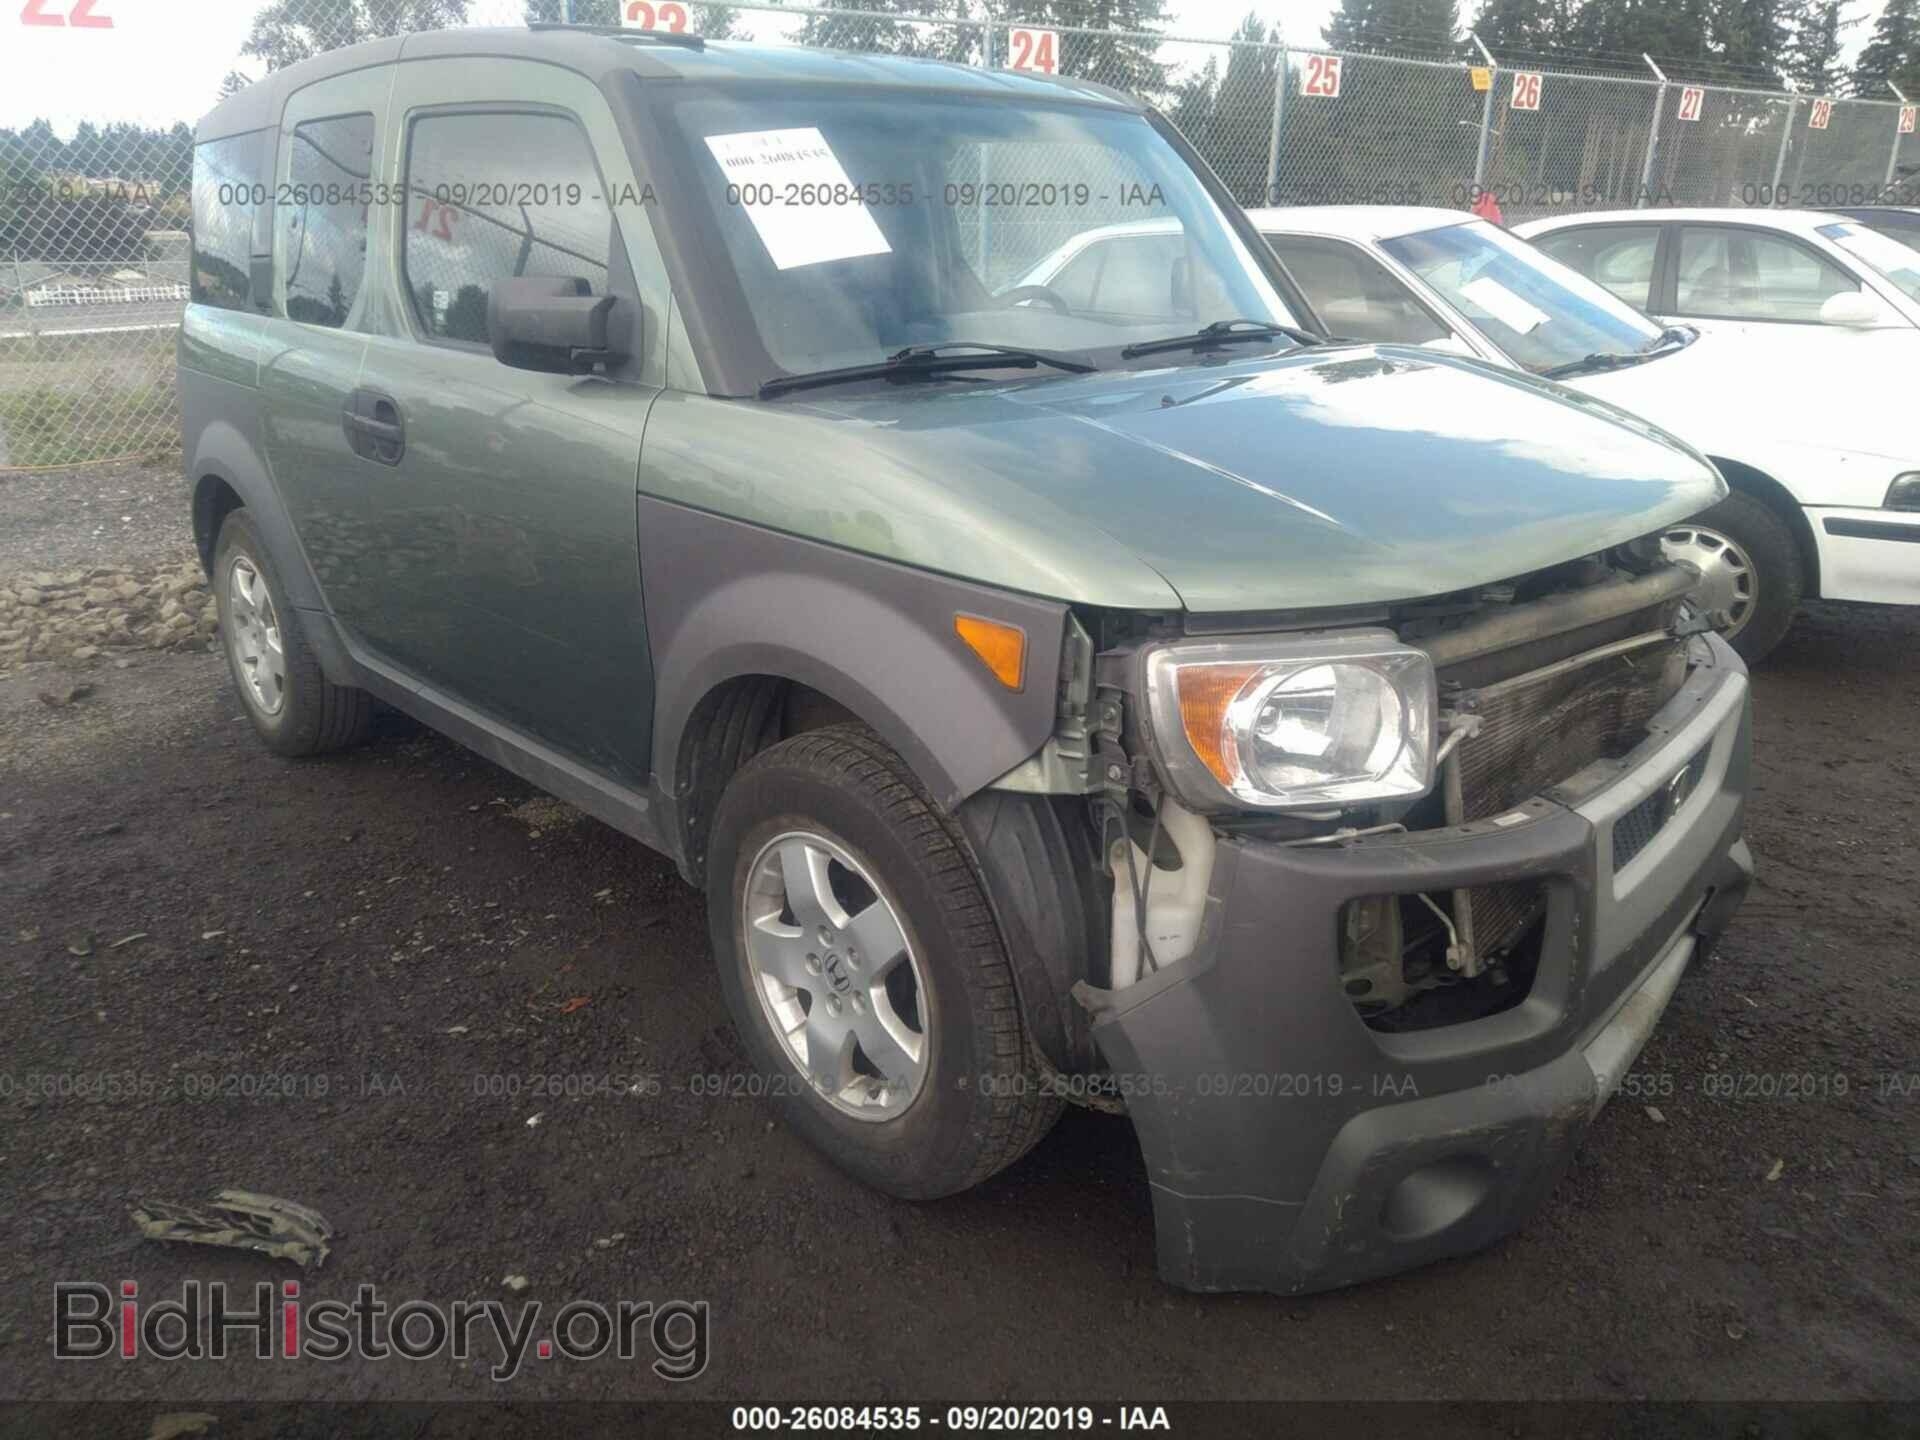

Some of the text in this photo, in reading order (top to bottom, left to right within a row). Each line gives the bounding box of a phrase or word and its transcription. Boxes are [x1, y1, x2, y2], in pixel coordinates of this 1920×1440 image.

[1013, 31, 1055, 74] 24
[1306, 56, 1338, 95] 25
[1513, 74, 1539, 107] 26
[1681, 90, 1701, 118] 27
